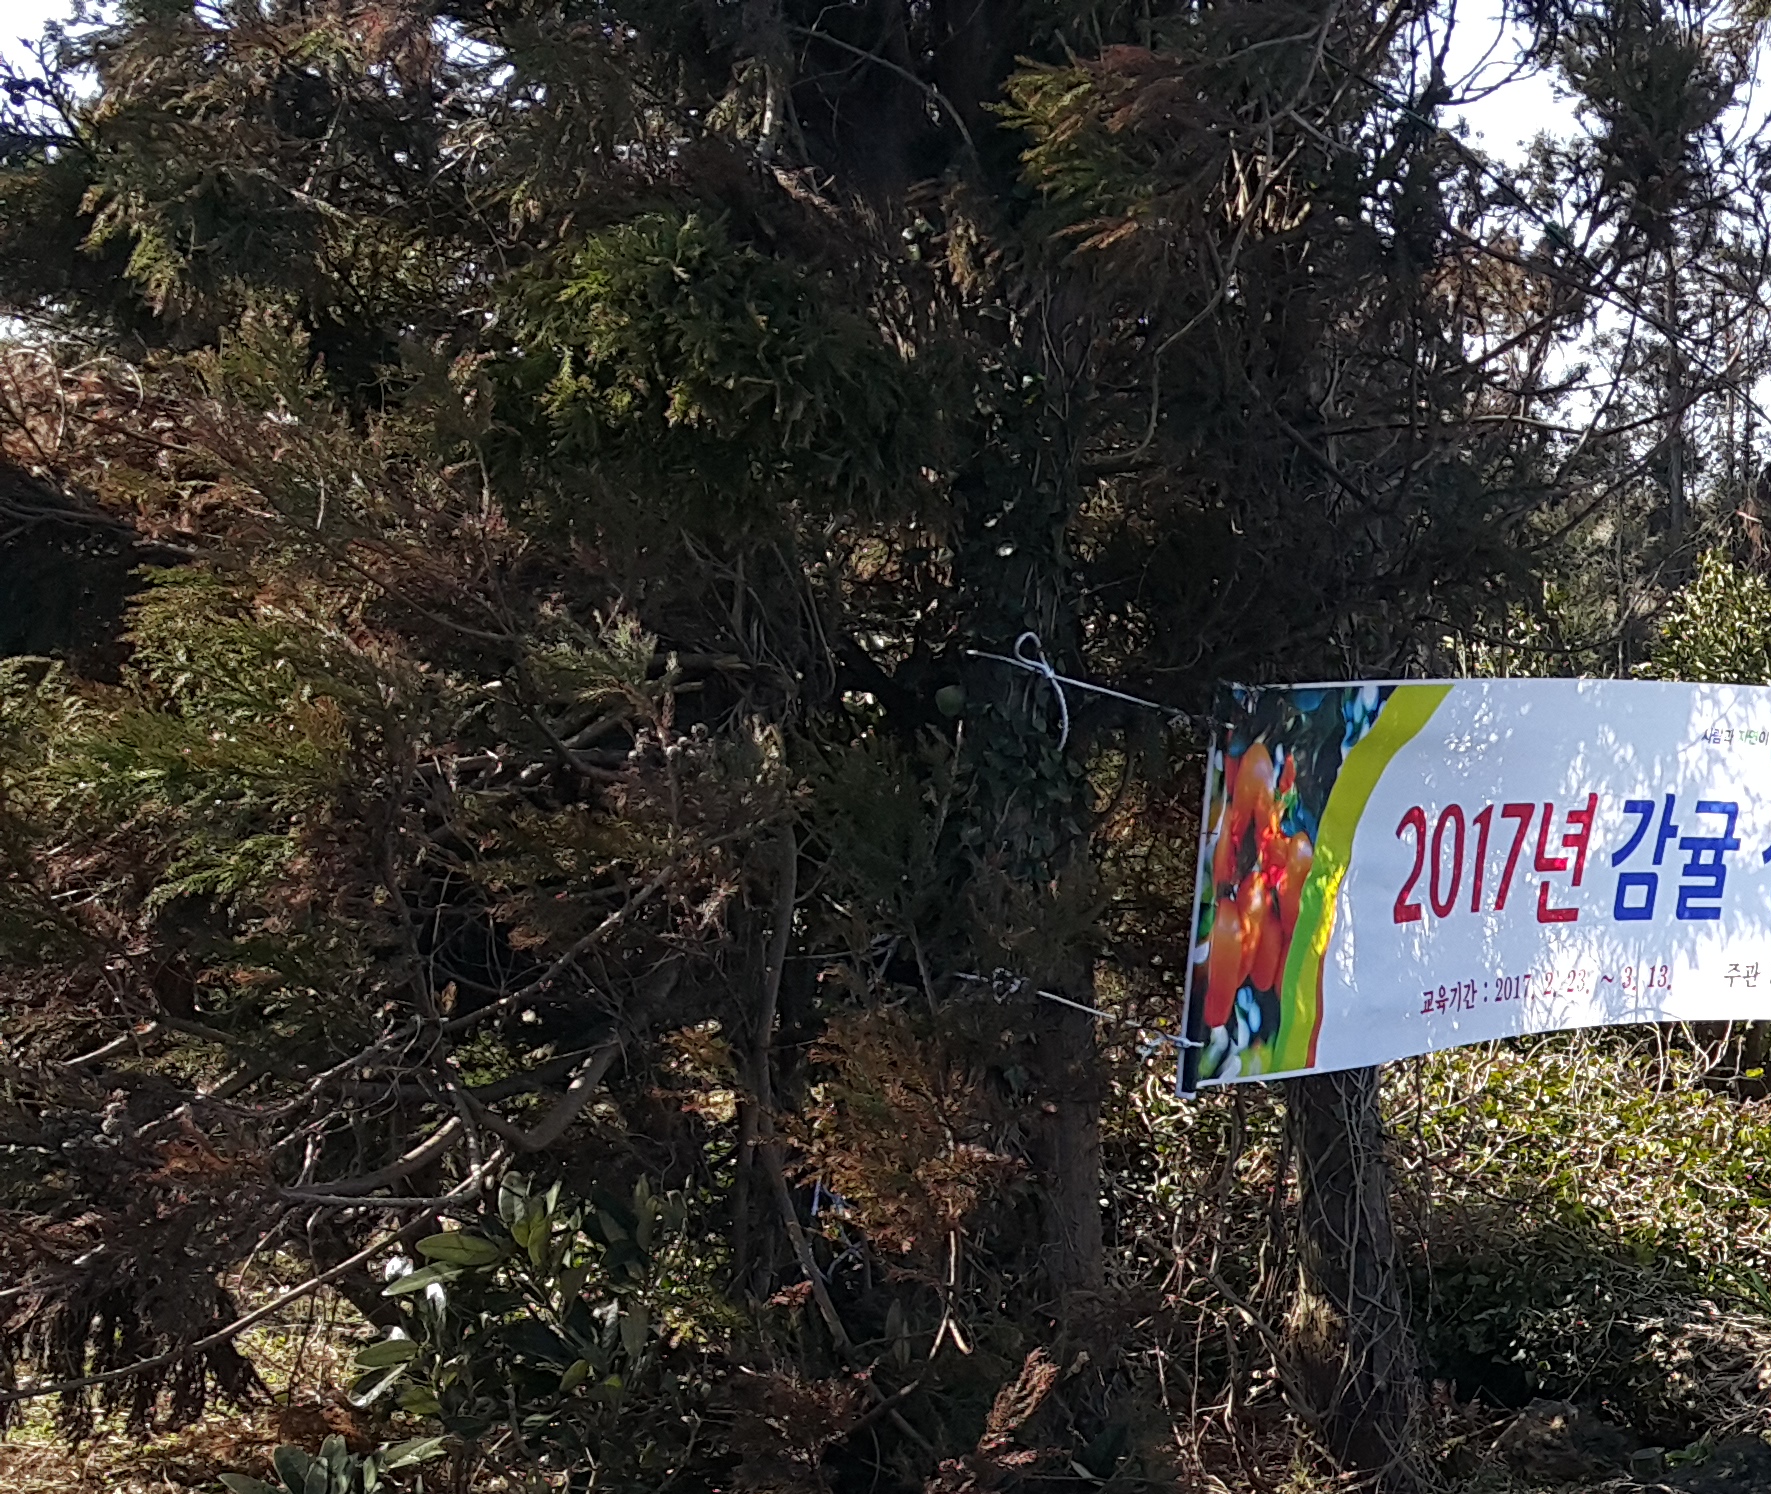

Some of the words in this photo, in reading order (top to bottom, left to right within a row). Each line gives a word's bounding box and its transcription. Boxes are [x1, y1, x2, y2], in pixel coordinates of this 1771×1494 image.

[1393, 793, 1598, 924] 2017년
[1611, 793, 1740, 921] 감귤
[1420, 979, 1477, 1015] 교육기간
[1494, 974, 1534, 1002] 2017.
[1647, 964, 1672, 991] 13.
[1723, 962, 1761, 989] 주관
